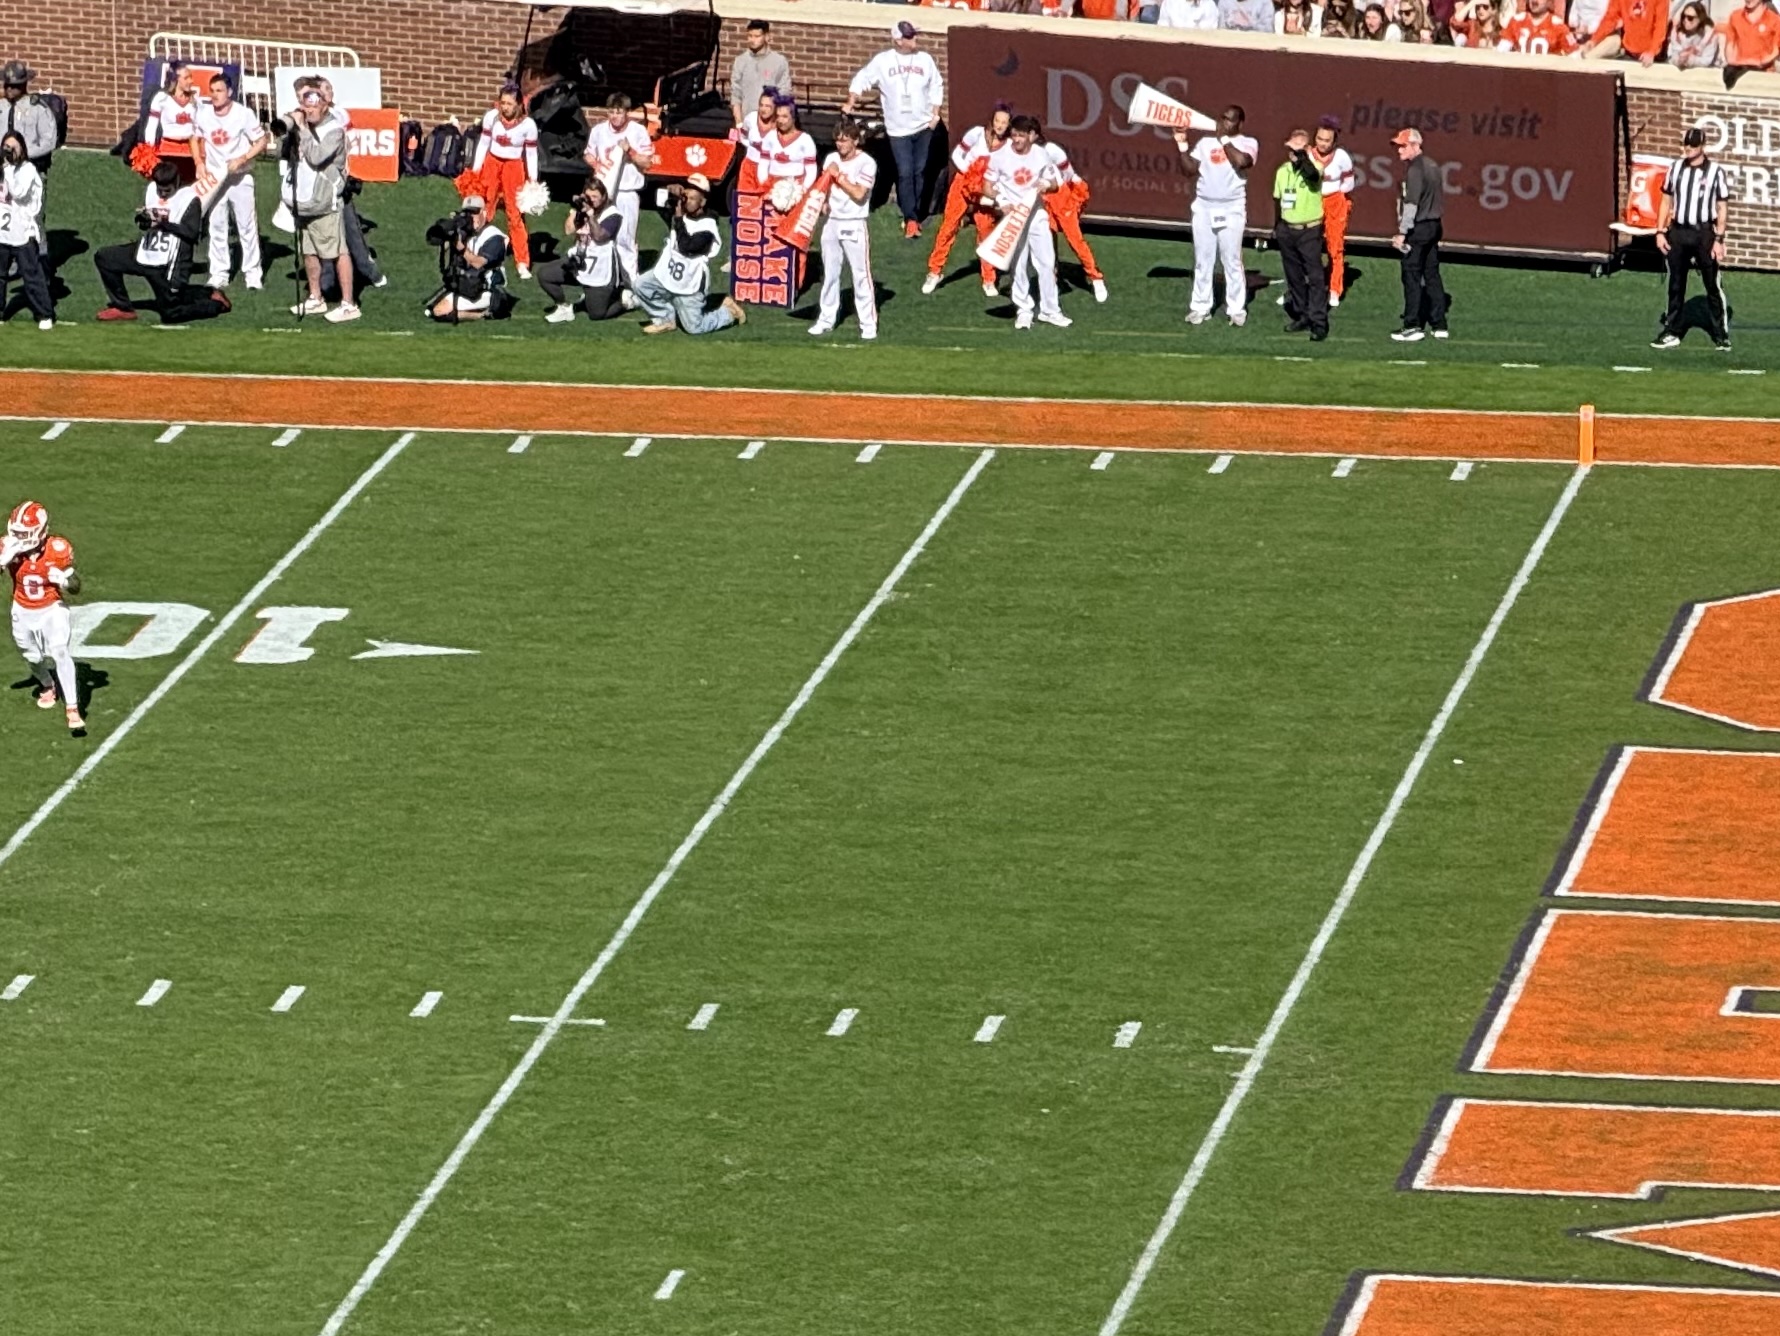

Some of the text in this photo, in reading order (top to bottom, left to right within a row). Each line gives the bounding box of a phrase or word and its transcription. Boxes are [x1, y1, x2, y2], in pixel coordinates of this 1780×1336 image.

[1146, 99, 1192, 128] TIGERS
[1352, 99, 1542, 139] please visit
[735, 195, 762, 304] NOISE
[991, 203, 1031, 259] CLEMSON
